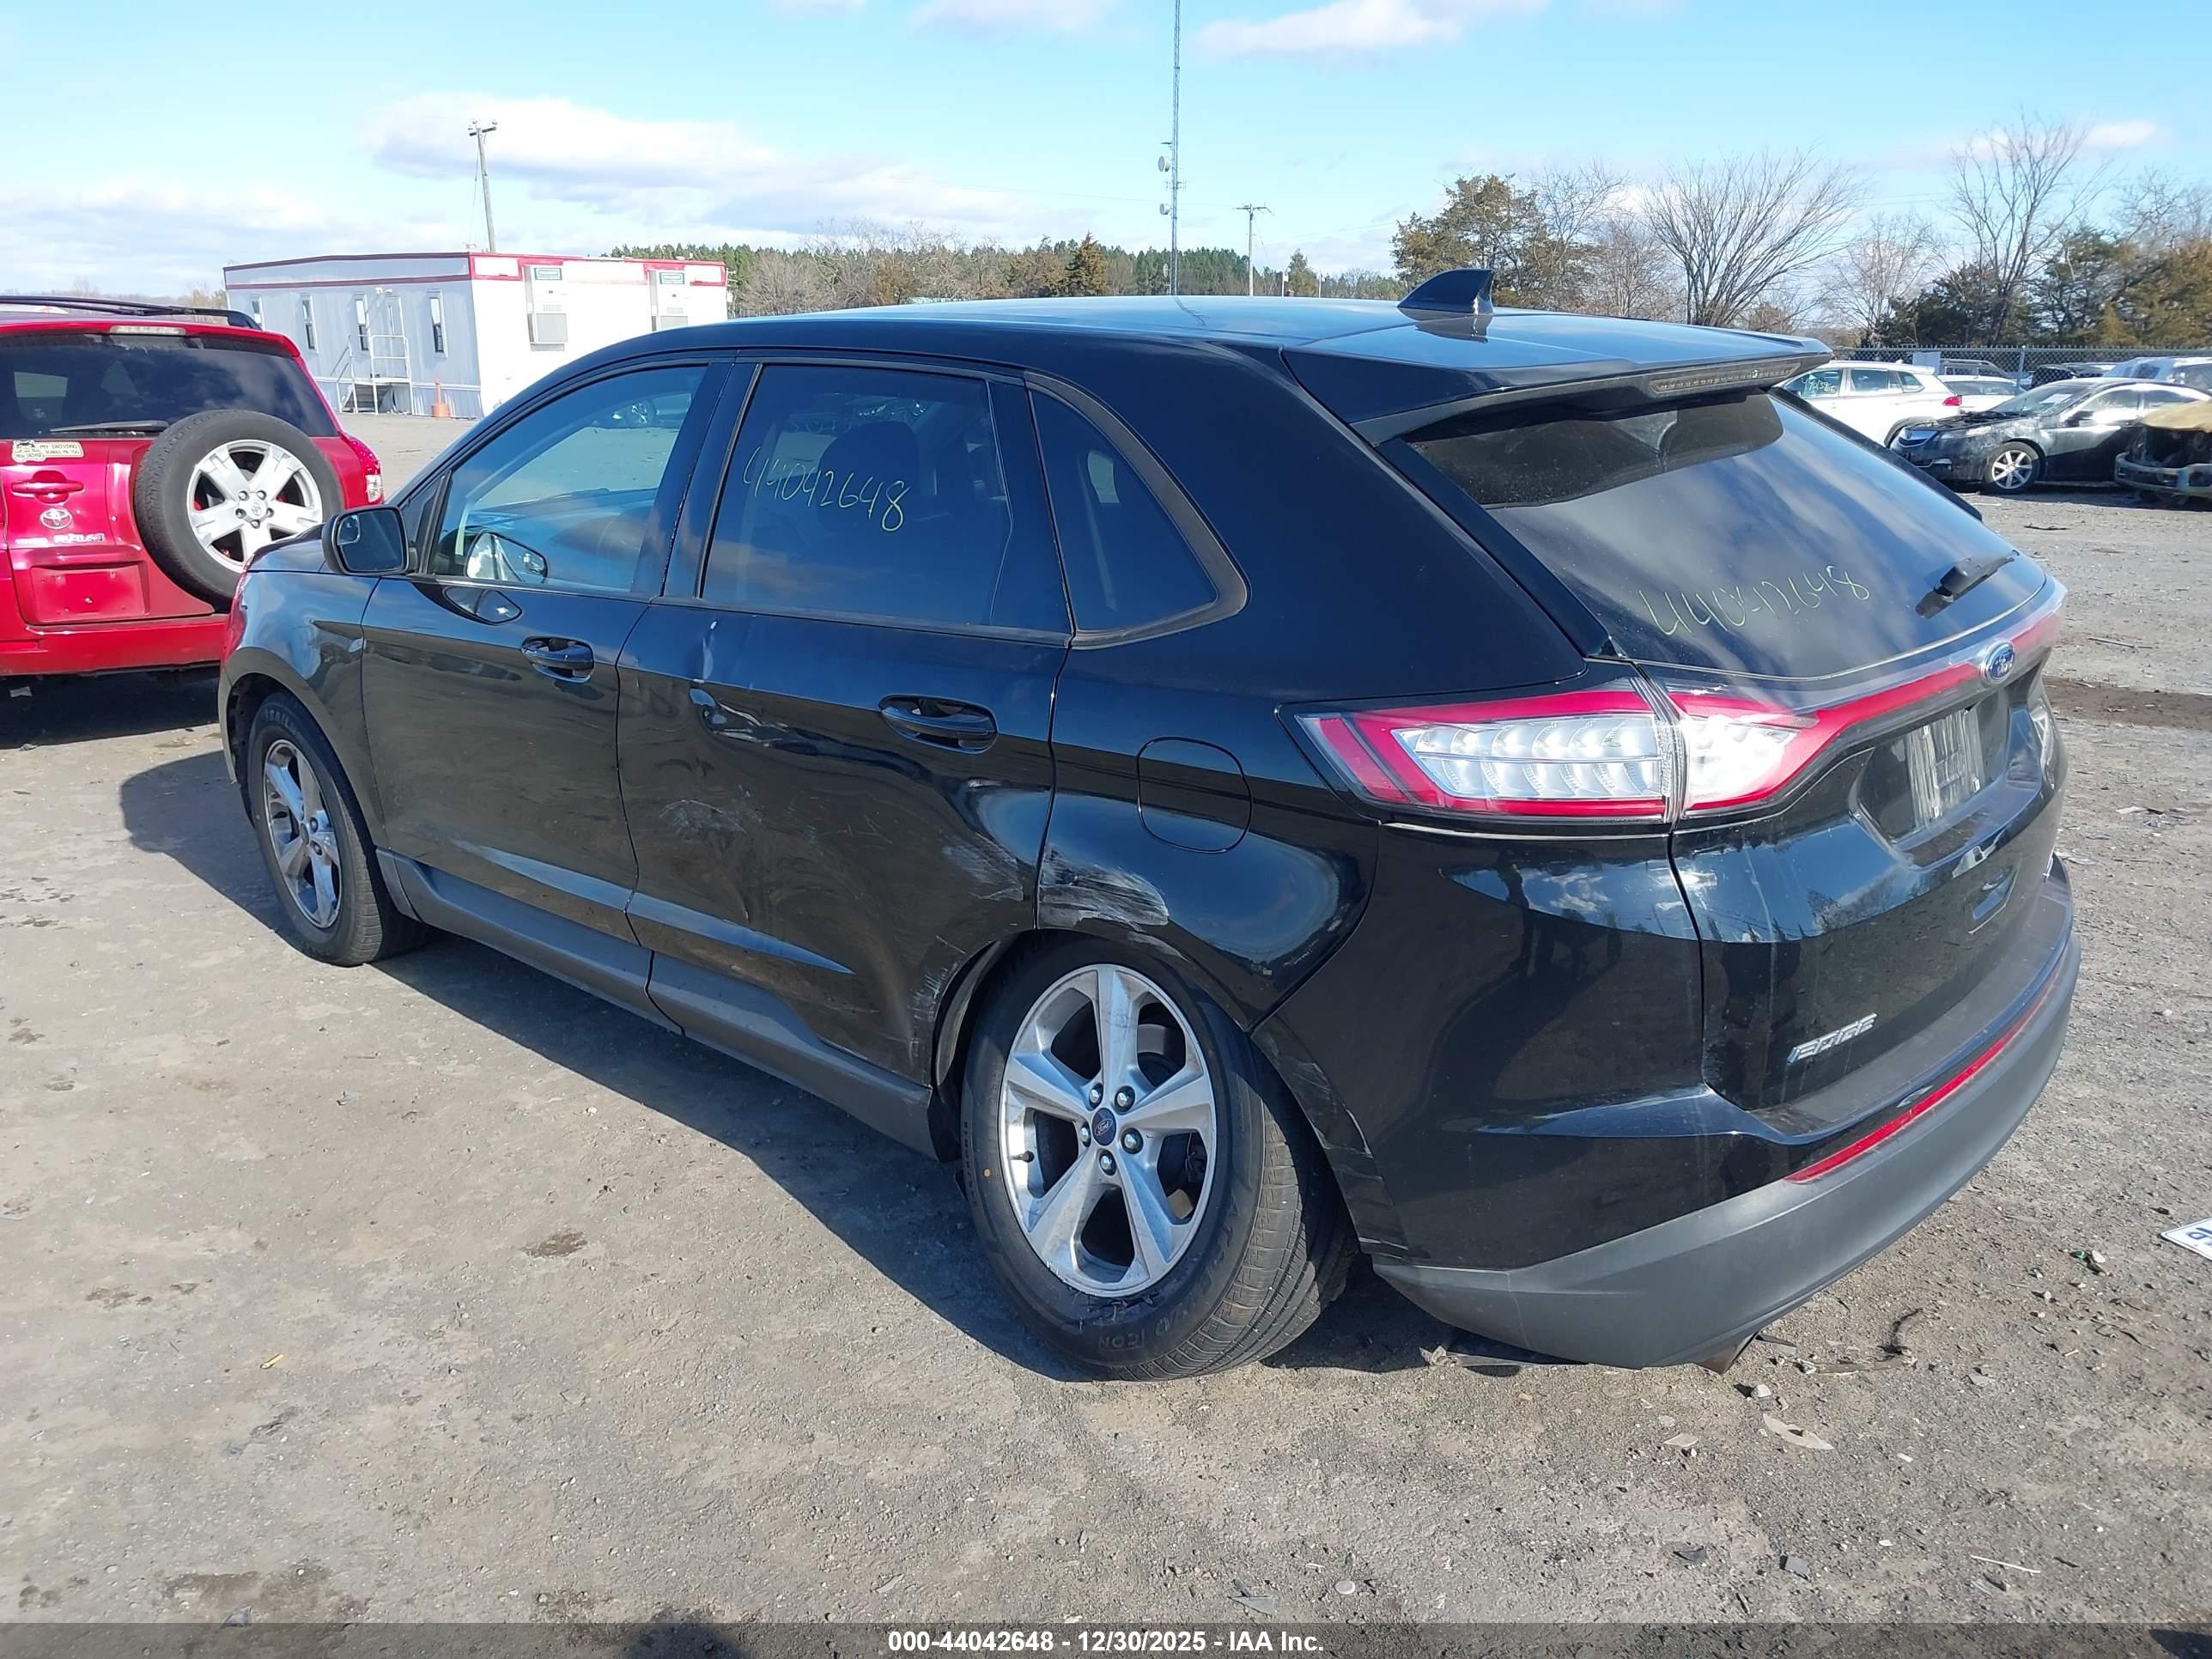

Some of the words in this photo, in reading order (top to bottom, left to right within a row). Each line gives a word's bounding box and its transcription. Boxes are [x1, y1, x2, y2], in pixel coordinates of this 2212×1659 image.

[743, 446, 911, 532] 44042648
[1787, 1013, 1878, 1063] EDGE
[1096, 1119, 1114, 1135] Ford
